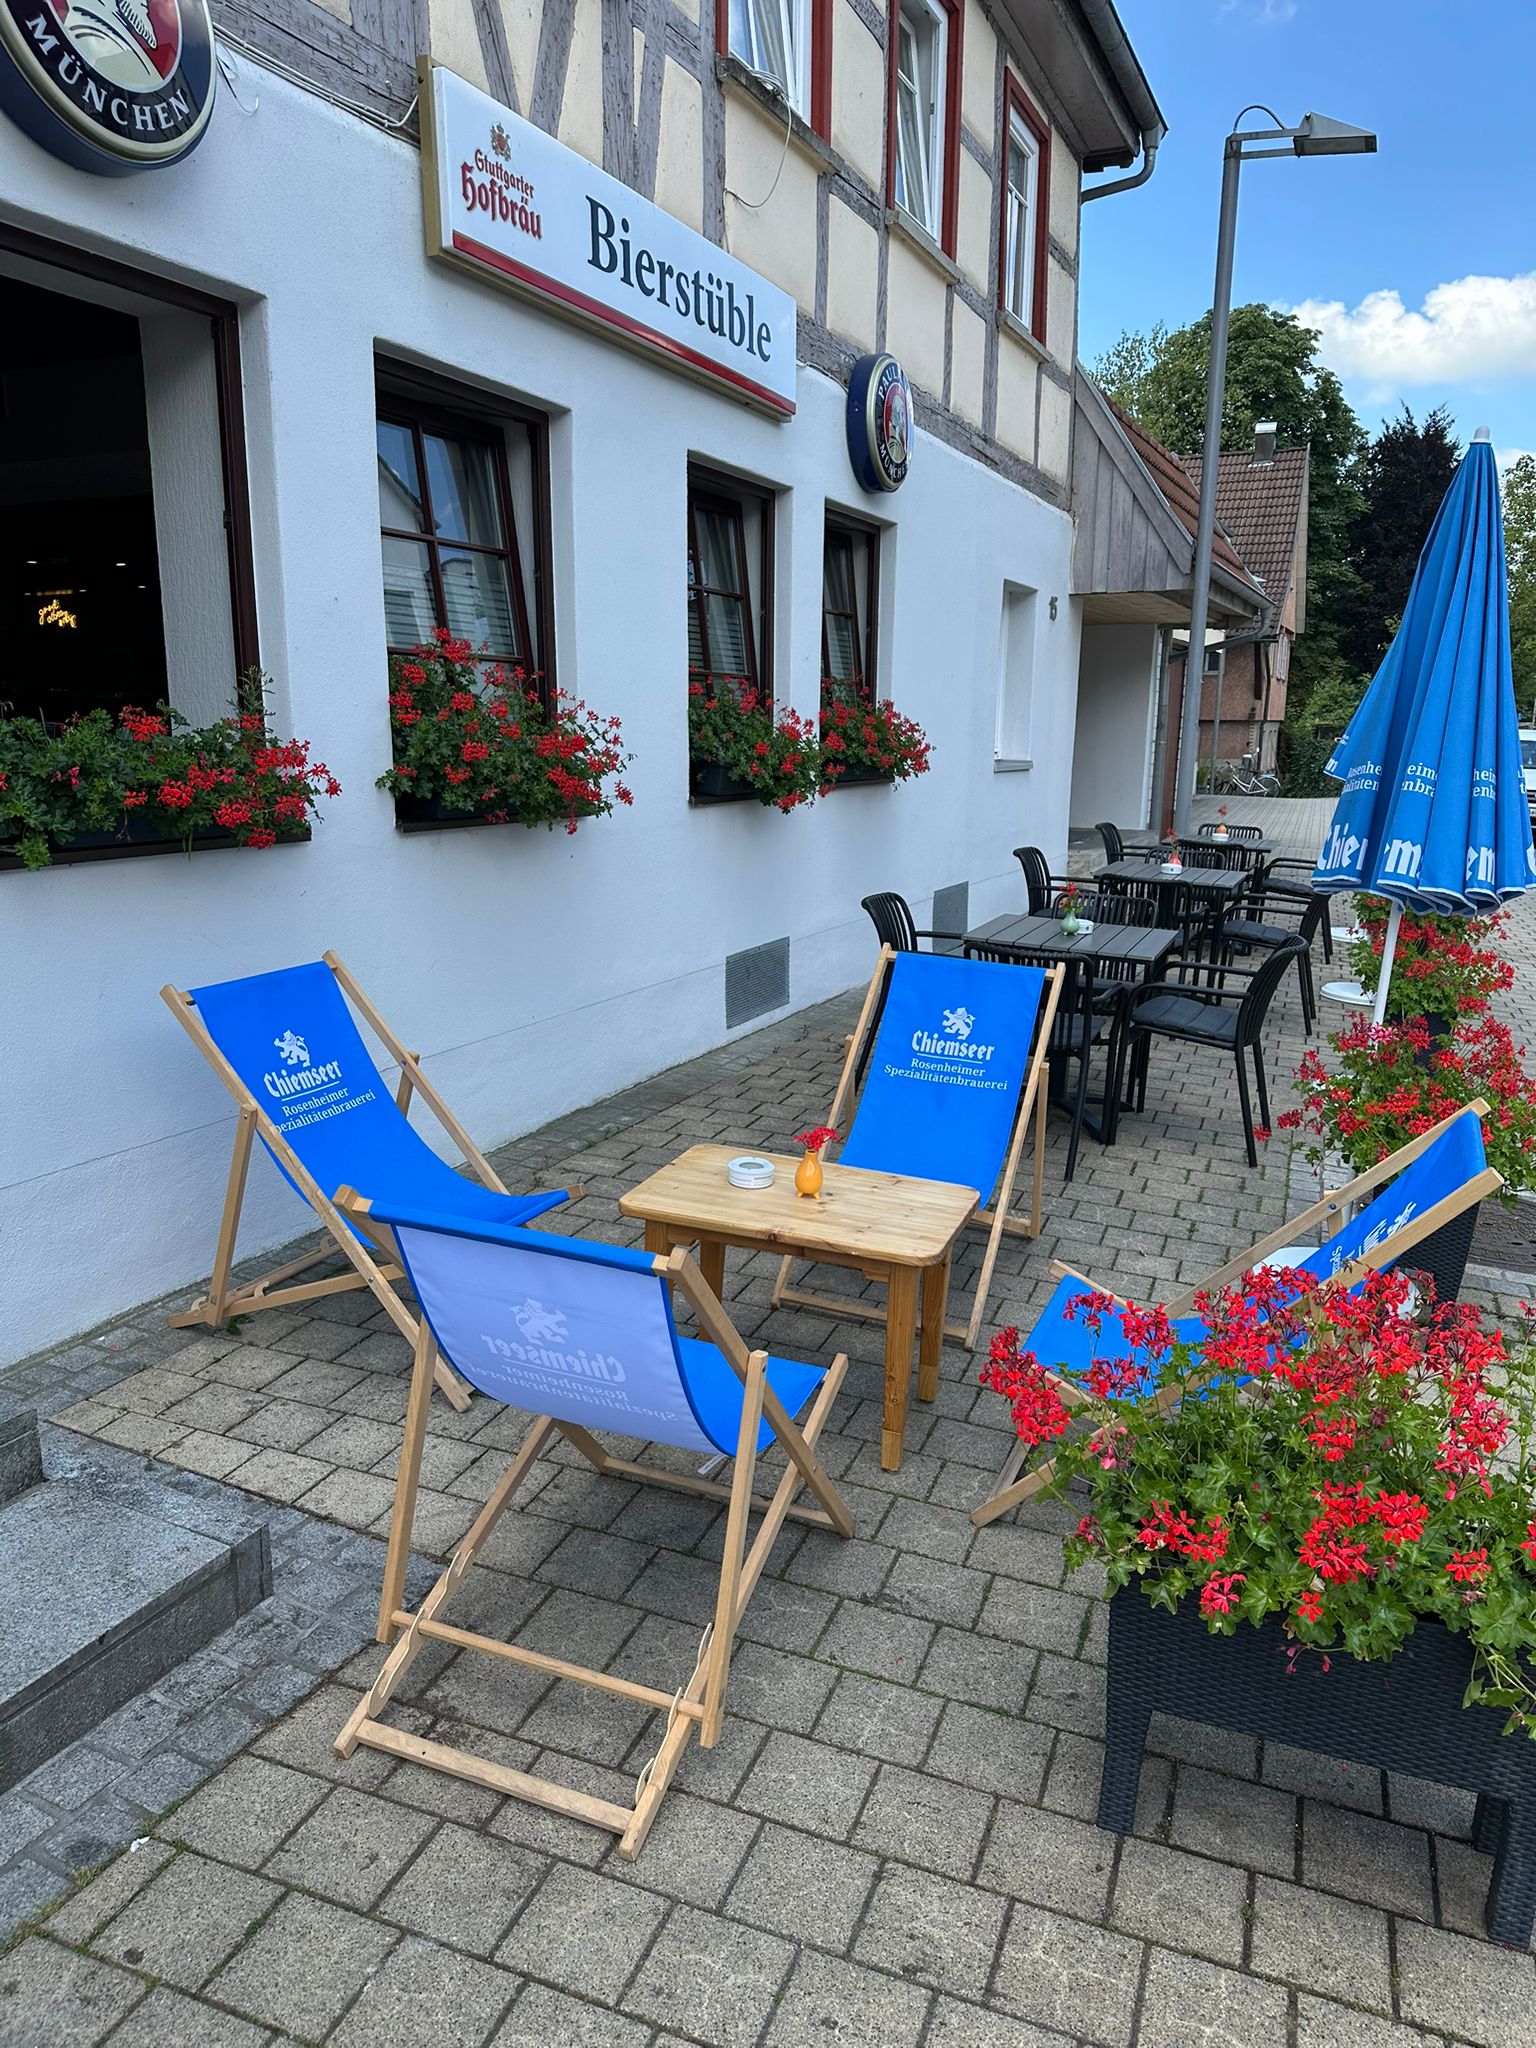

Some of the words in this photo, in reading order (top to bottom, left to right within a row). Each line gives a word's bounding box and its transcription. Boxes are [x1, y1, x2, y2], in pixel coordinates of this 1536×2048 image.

[25, 13, 191, 132] MÜNCHEN
[474, 148, 535, 199] Stuttgarter
[460, 161, 543, 240] Hofbräu
[585, 194, 772, 363] Bierstüble
[911, 1030, 996, 1061] Chiemseer
[263, 1059, 343, 1098] Chiemseer
[884, 1063, 1008, 1091] Spezialitätenbrauerei
[910, 1057, 986, 1077] Rosenheimer
[274, 1089, 377, 1134] pezialitätenbrauerei
[281, 1087, 349, 1117] Rosenheimer
